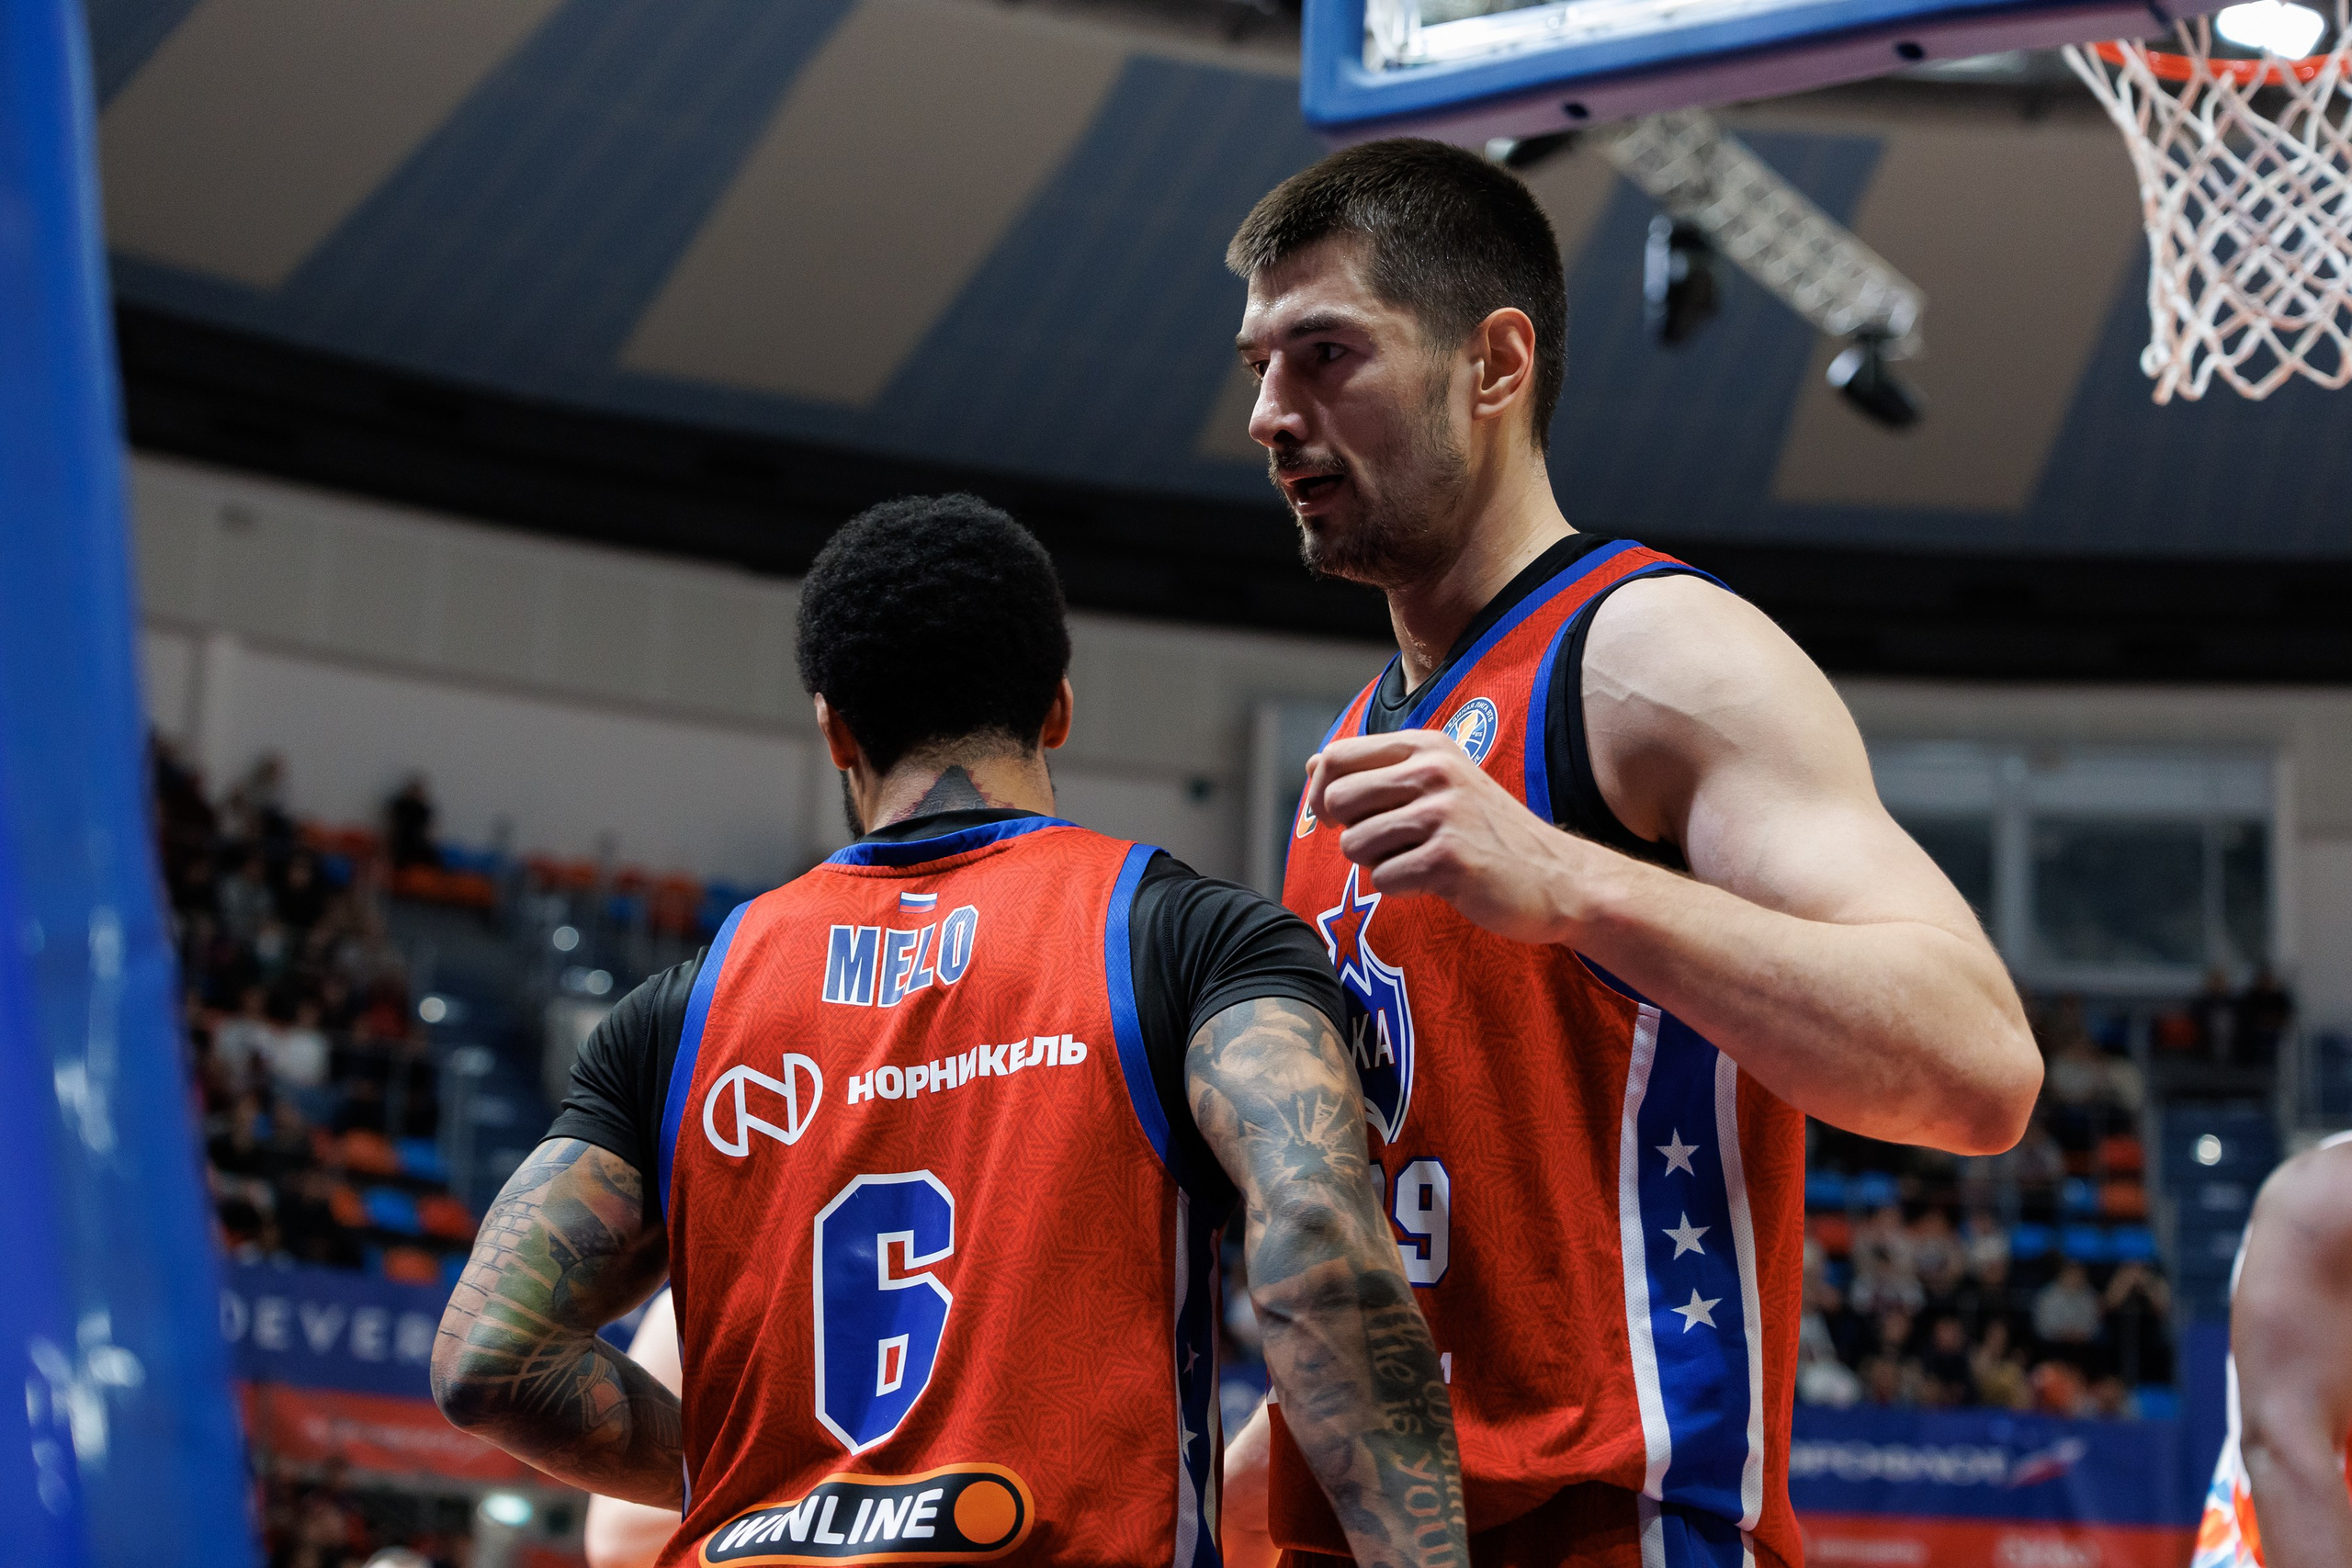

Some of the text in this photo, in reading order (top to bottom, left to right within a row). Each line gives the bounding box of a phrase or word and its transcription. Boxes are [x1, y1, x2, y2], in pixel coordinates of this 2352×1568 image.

[1449, 701, 1494, 728] ЕДИНАЯ ЛИГА ВТБ
[821, 904, 979, 1008] MELO
[847, 1033, 1088, 1104] НОРНИКЕЛЬ
[1370, 1156, 1452, 1288] 9
[813, 1168, 956, 1457] 6
[717, 1486, 944, 1553] WINLINE
